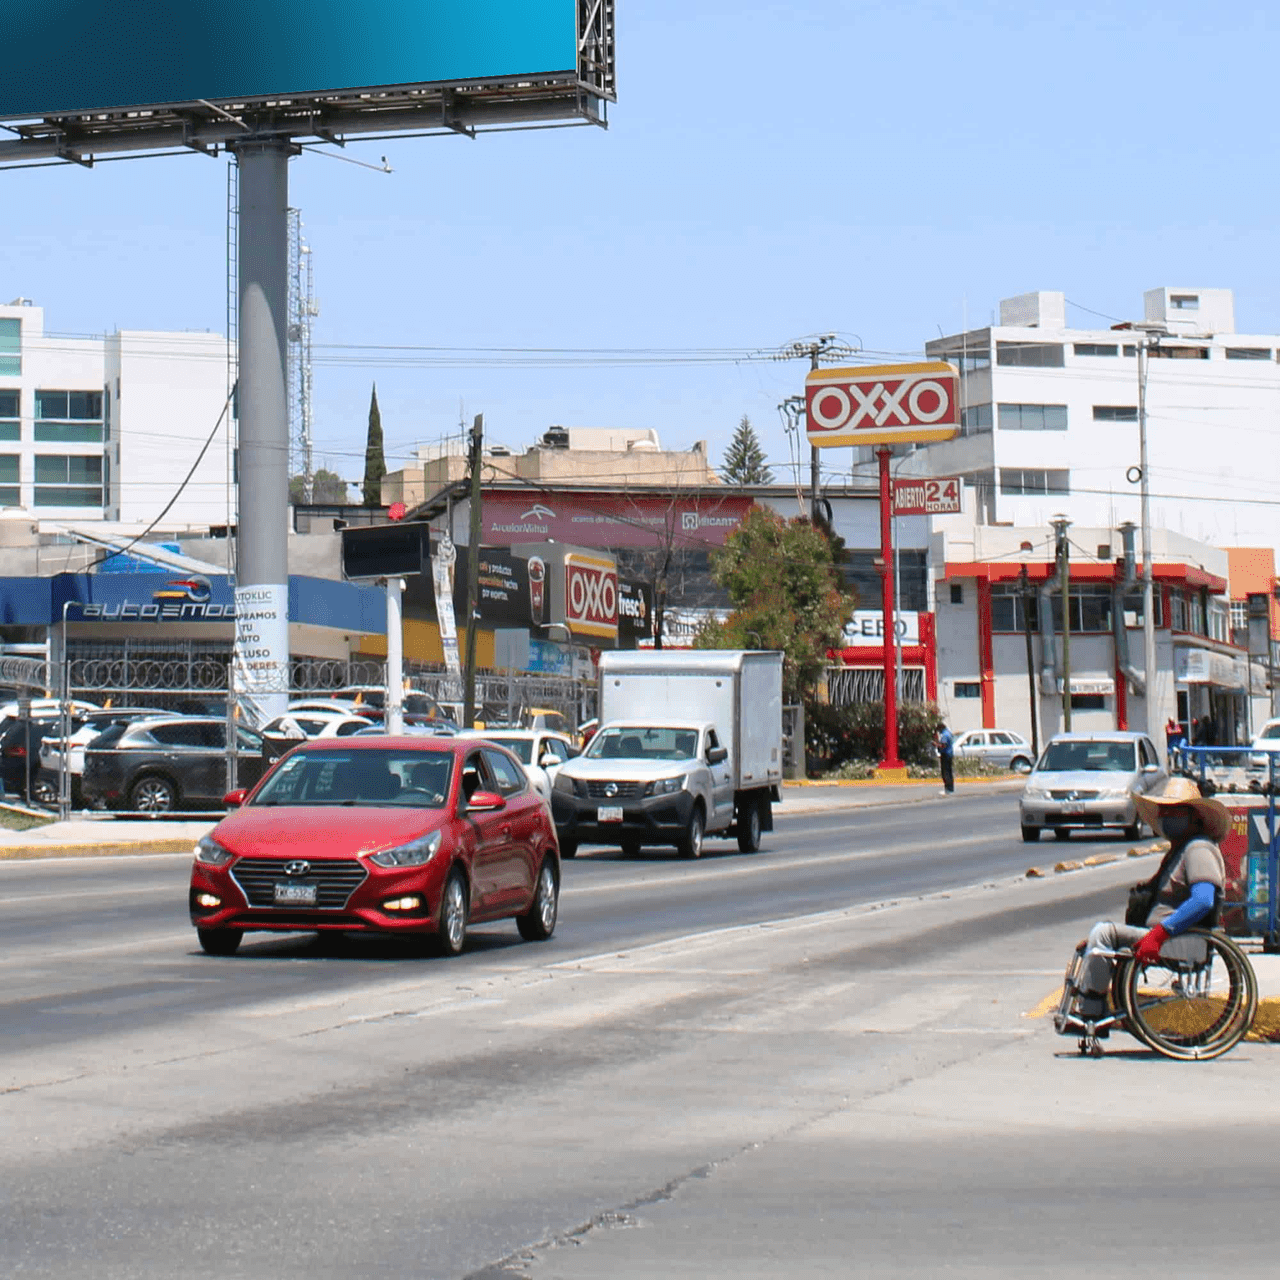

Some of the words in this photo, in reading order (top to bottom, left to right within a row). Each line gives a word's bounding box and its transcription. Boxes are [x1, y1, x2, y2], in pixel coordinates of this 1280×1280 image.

[811, 378, 949, 430] OXXO
[895, 486, 925, 509] ABIERTO
[926, 482, 958, 503] 24
[926, 502, 958, 512] HORAS
[235, 591, 272, 601] UTOKLIC
[571, 571, 616, 620] OXXO
[242, 624, 253, 633] TU
